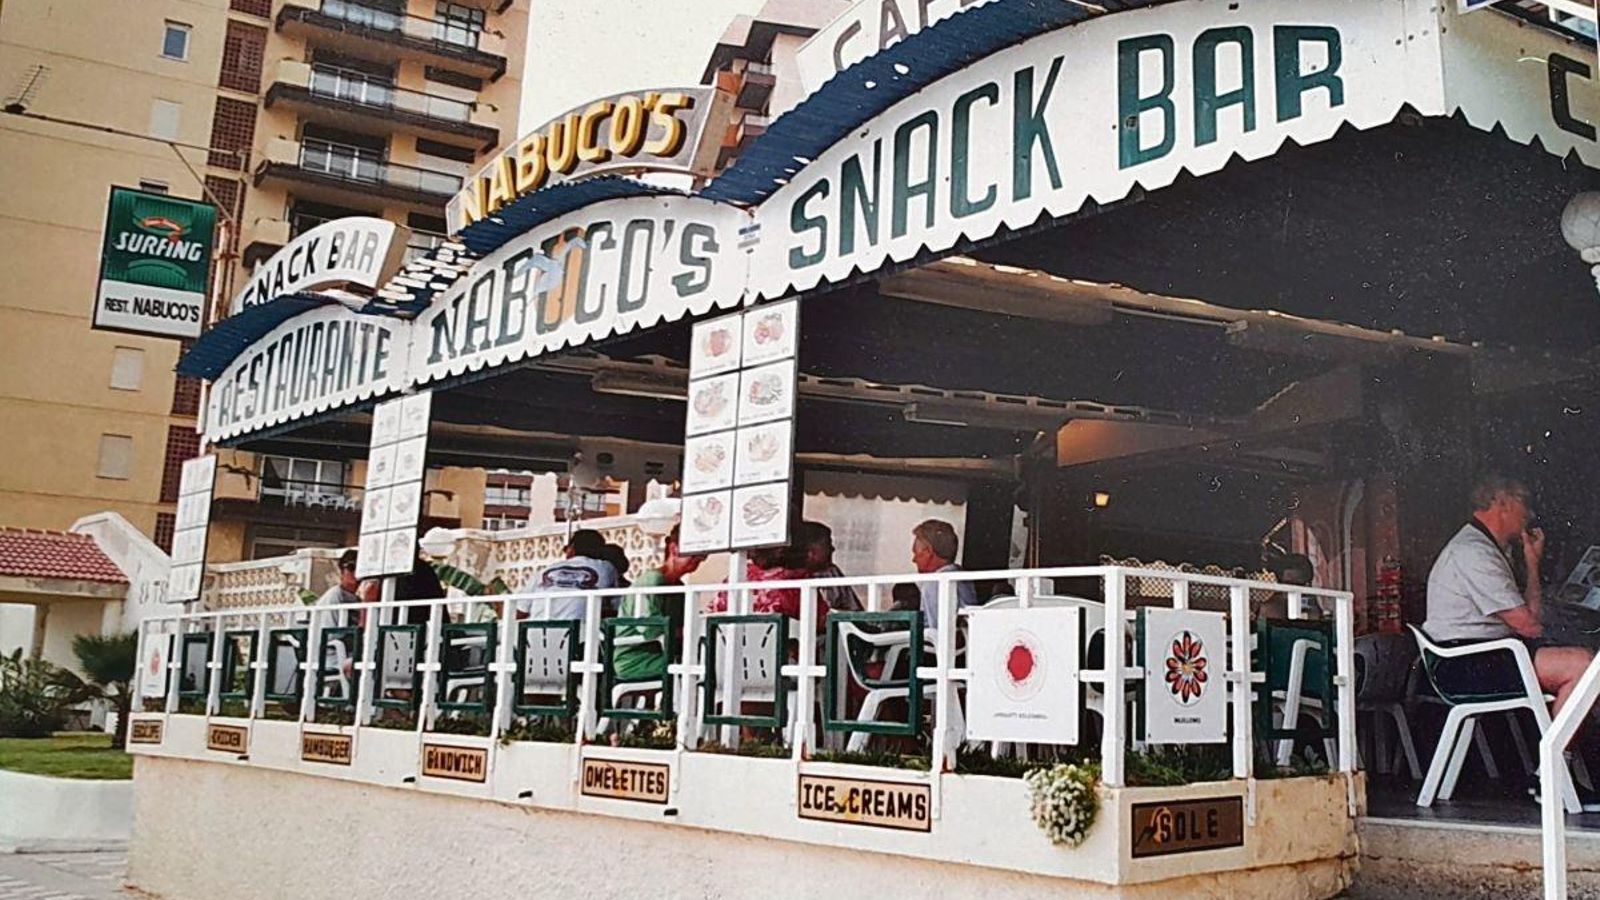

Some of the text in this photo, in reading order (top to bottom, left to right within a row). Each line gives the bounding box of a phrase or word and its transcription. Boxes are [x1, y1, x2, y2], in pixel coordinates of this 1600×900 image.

[461, 91, 696, 226] NABUCO'S
[789, 24, 1346, 271] SNACK BAR
[114, 231, 203, 262] SURFING
[243, 229, 379, 310] SNACK BAR
[133, 297, 201, 323] NABUCO'S
[427, 219, 719, 364] NABUCO'S
[218, 319, 391, 427] RESTAURANTE
[427, 750, 482, 774] SANDWICH
[585, 766, 666, 796] OMELETTES
[803, 783, 926, 821] ICE CREAMS
[1160, 808, 1218, 843] SOLE
